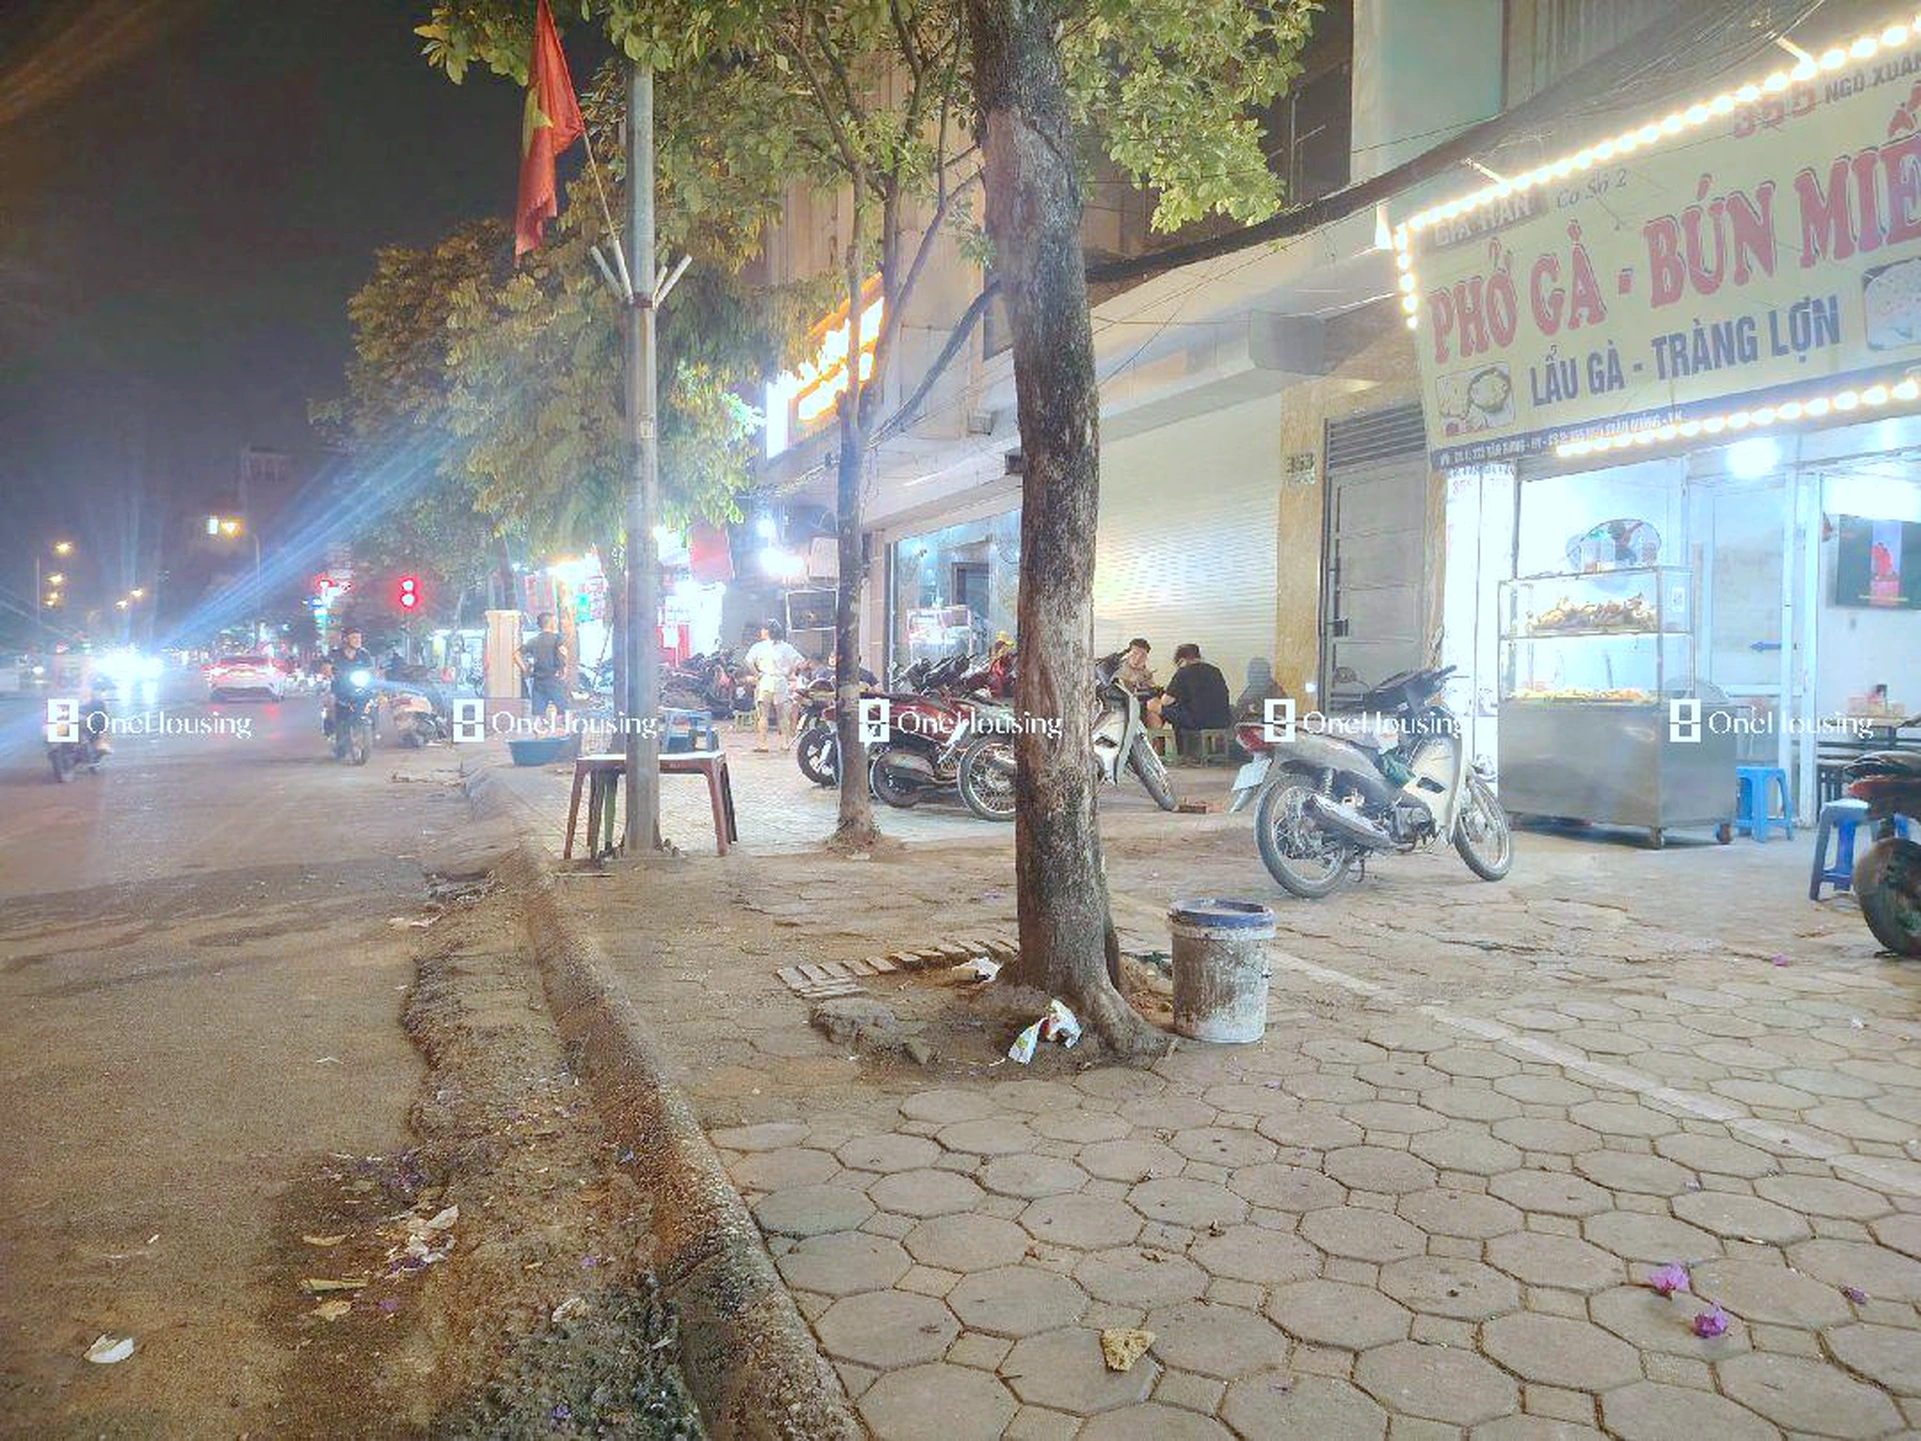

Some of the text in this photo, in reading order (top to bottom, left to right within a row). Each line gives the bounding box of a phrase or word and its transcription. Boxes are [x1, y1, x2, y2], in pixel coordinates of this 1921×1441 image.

[1427, 237, 1518, 363] PHỞ
[1530, 217, 1607, 336] GÀ
[1618, 268, 1634, 294] -
[1643, 173, 1777, 308] BÚN
[1530, 344, 1578, 407] LẨU
[1586, 339, 1625, 395] GÀ
[1651, 318, 1758, 380] TRÀNG
[1768, 295, 1841, 363] LỢN
